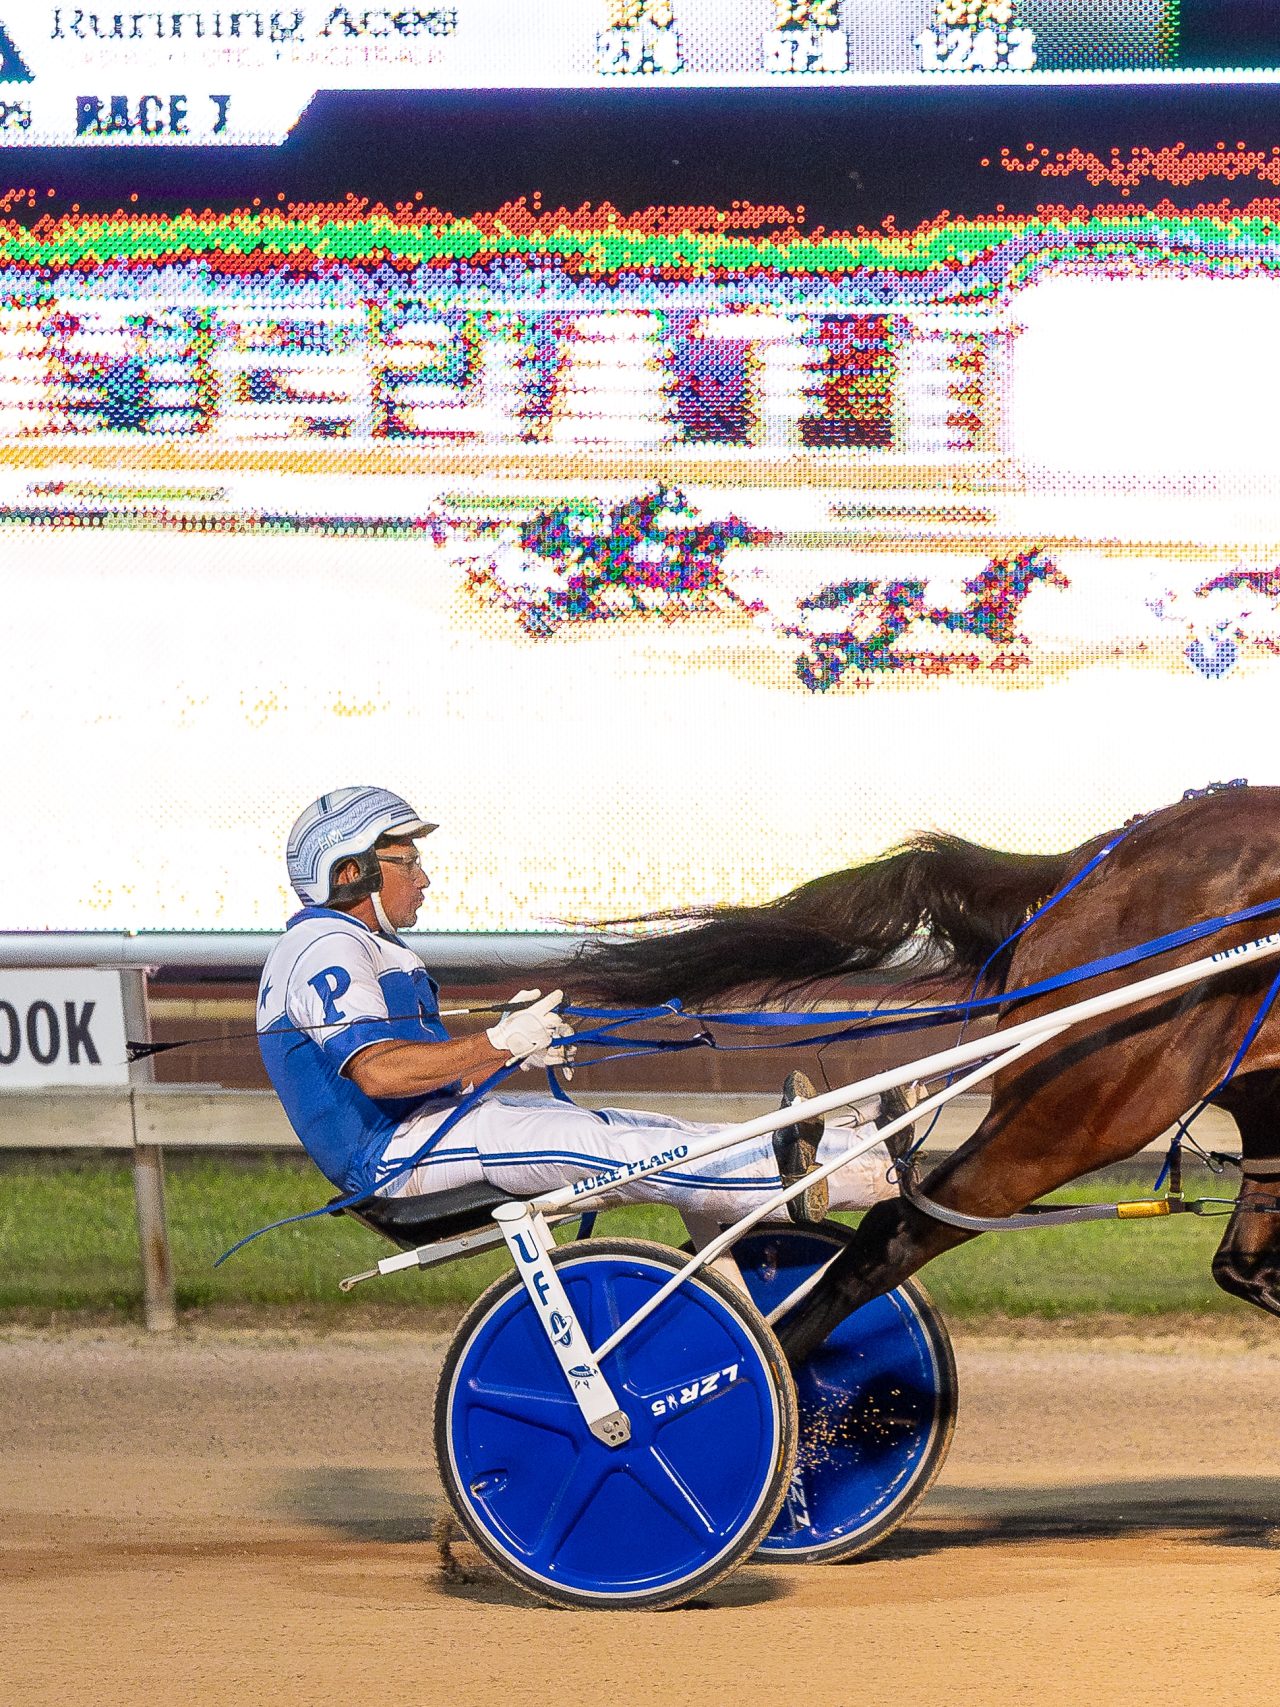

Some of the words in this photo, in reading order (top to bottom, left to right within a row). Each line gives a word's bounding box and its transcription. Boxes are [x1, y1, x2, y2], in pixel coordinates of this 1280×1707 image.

[51, 8, 305, 42] Running
[76, 95, 189, 136] RACE
[307, 965, 351, 1024] P
[572, 1168, 622, 1195] LUKE
[626, 1145, 688, 1176] PLANO
